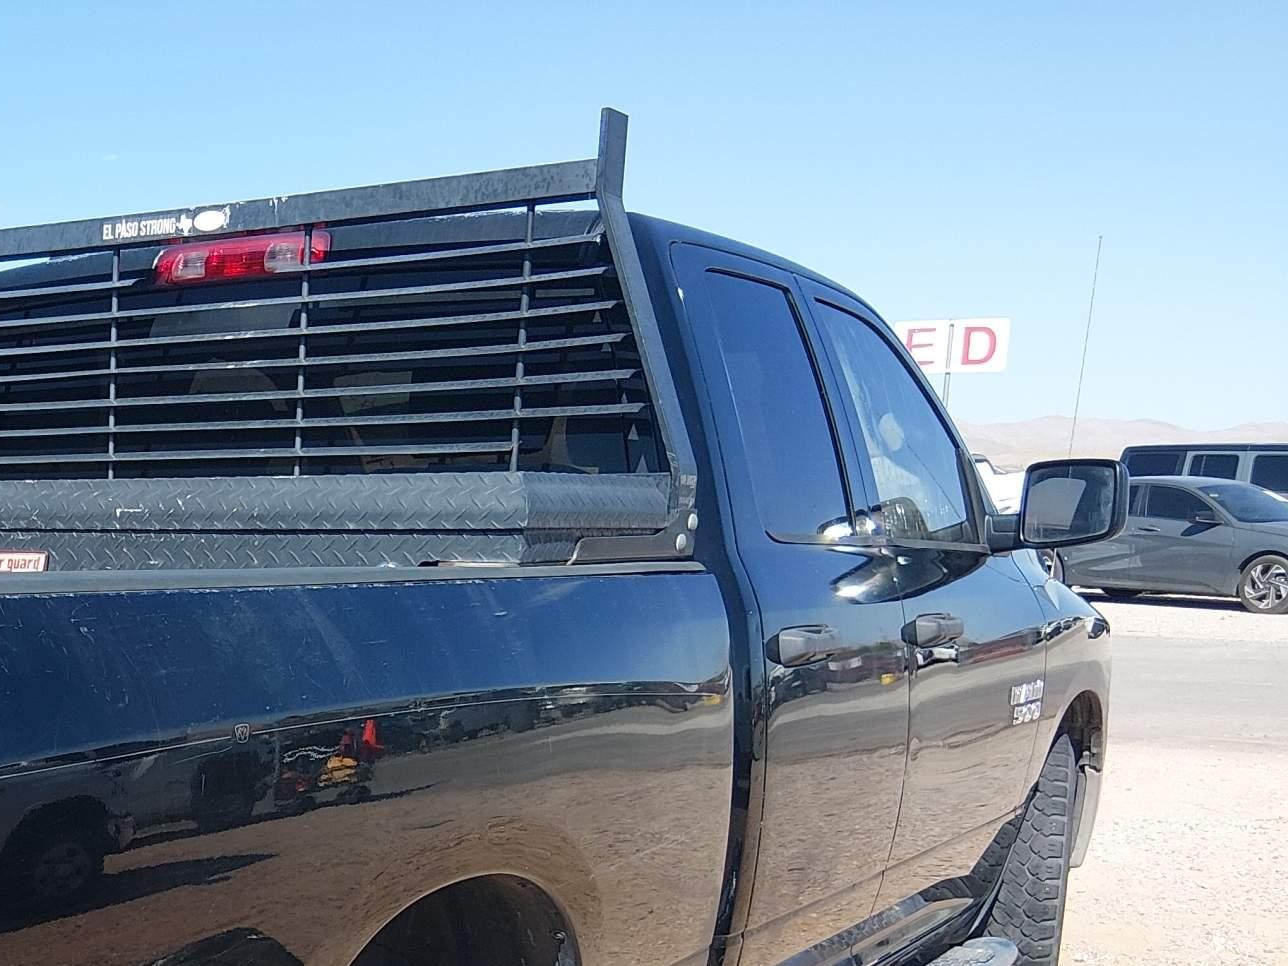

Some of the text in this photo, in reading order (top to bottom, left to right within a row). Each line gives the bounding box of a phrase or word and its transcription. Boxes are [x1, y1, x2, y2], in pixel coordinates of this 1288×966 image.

[102, 217, 176, 240] EL PASO STRONG
[7, 556, 41, 570] guard
